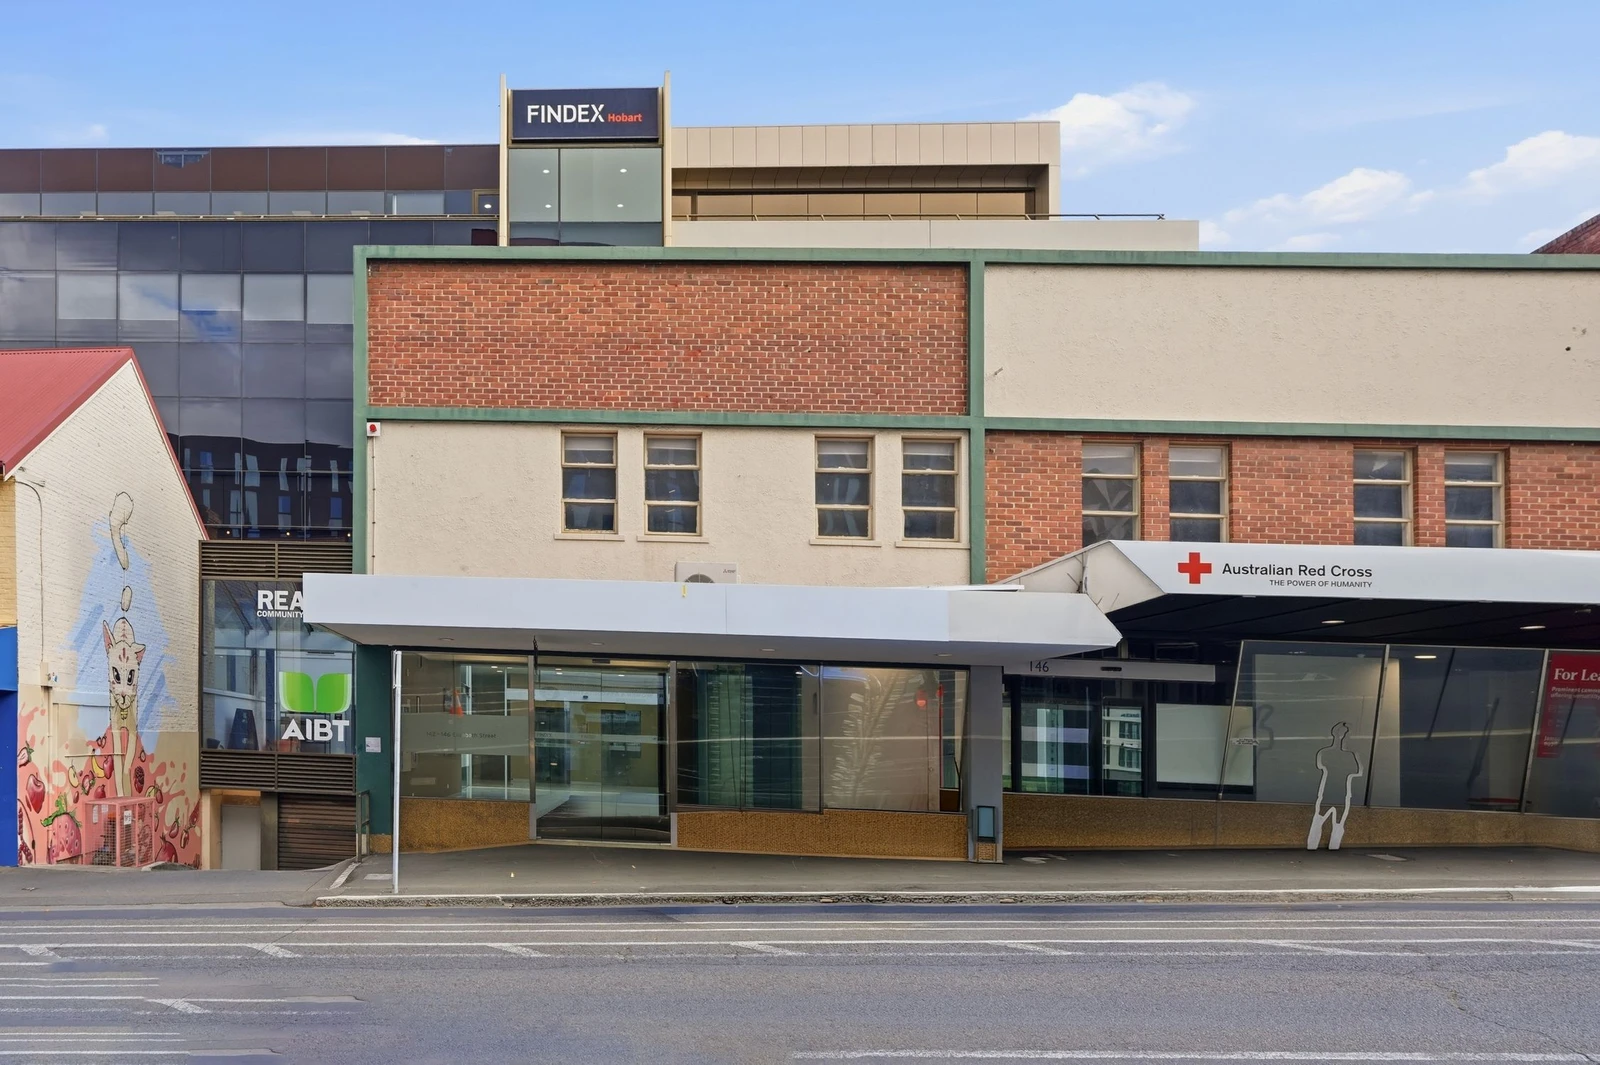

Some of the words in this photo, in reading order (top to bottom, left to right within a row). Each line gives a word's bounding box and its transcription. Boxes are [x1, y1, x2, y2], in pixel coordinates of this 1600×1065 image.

[527, 104, 605, 123] FINDEX
[608, 113, 642, 122] Hobart
[1222, 563, 1293, 575] Australian
[1298, 565, 1325, 576] Red
[1331, 565, 1372, 577] Cross
[257, 590, 303, 610] REA
[257, 610, 303, 618] COMMUNITY
[1030, 660, 1049, 672] 146
[1554, 668, 1578, 680] For
[281, 718, 350, 742] AIBT
